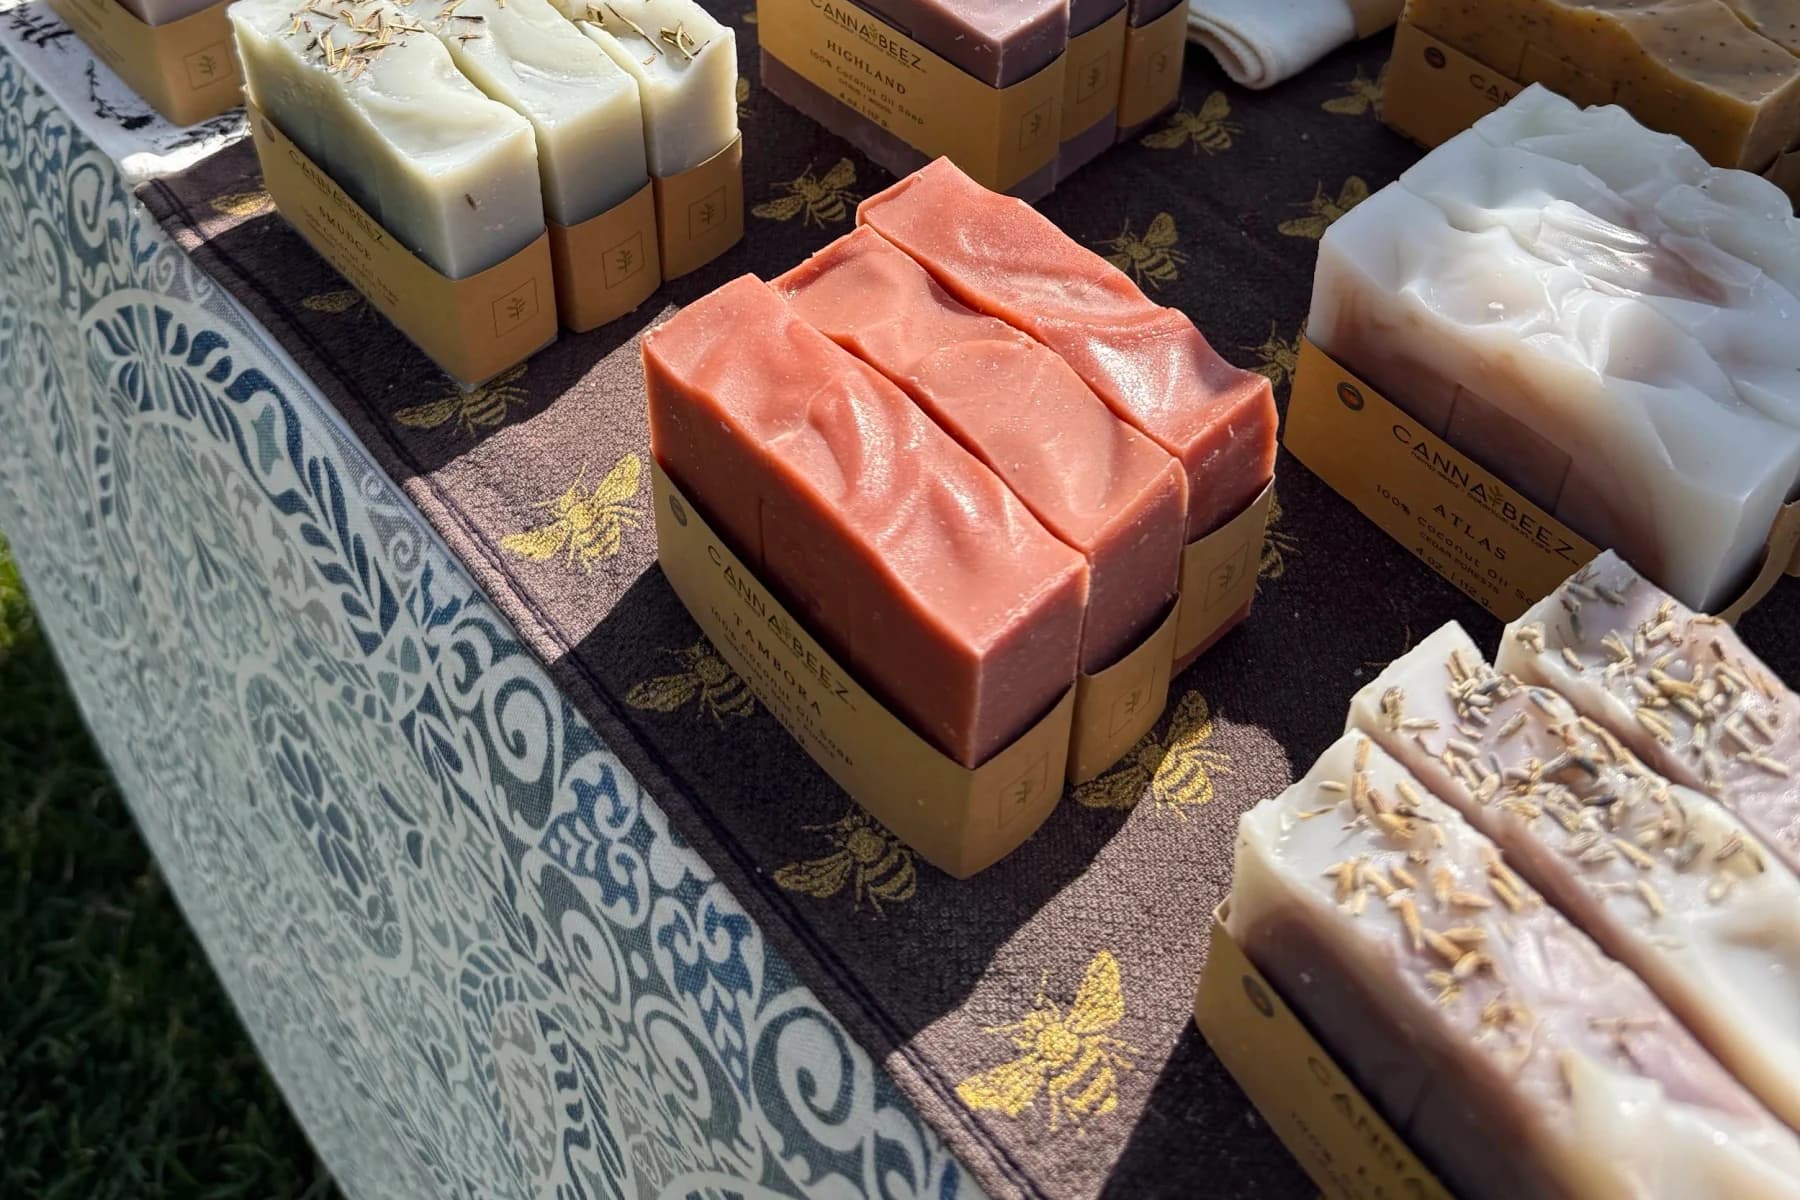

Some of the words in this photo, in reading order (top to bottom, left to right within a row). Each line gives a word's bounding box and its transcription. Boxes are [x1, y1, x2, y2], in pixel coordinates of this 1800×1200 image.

[826, 39, 906, 95] HIGHLAND
[897, 104, 925, 126] Soap
[1375, 484, 1412, 517] 100%
[1417, 516, 1481, 568] Coconut
[1487, 568, 1509, 588] Oil
[1432, 502, 1507, 561] ATLAS
[733, 611, 822, 717] TAMBORA
[740, 641, 790, 701] Coconut
